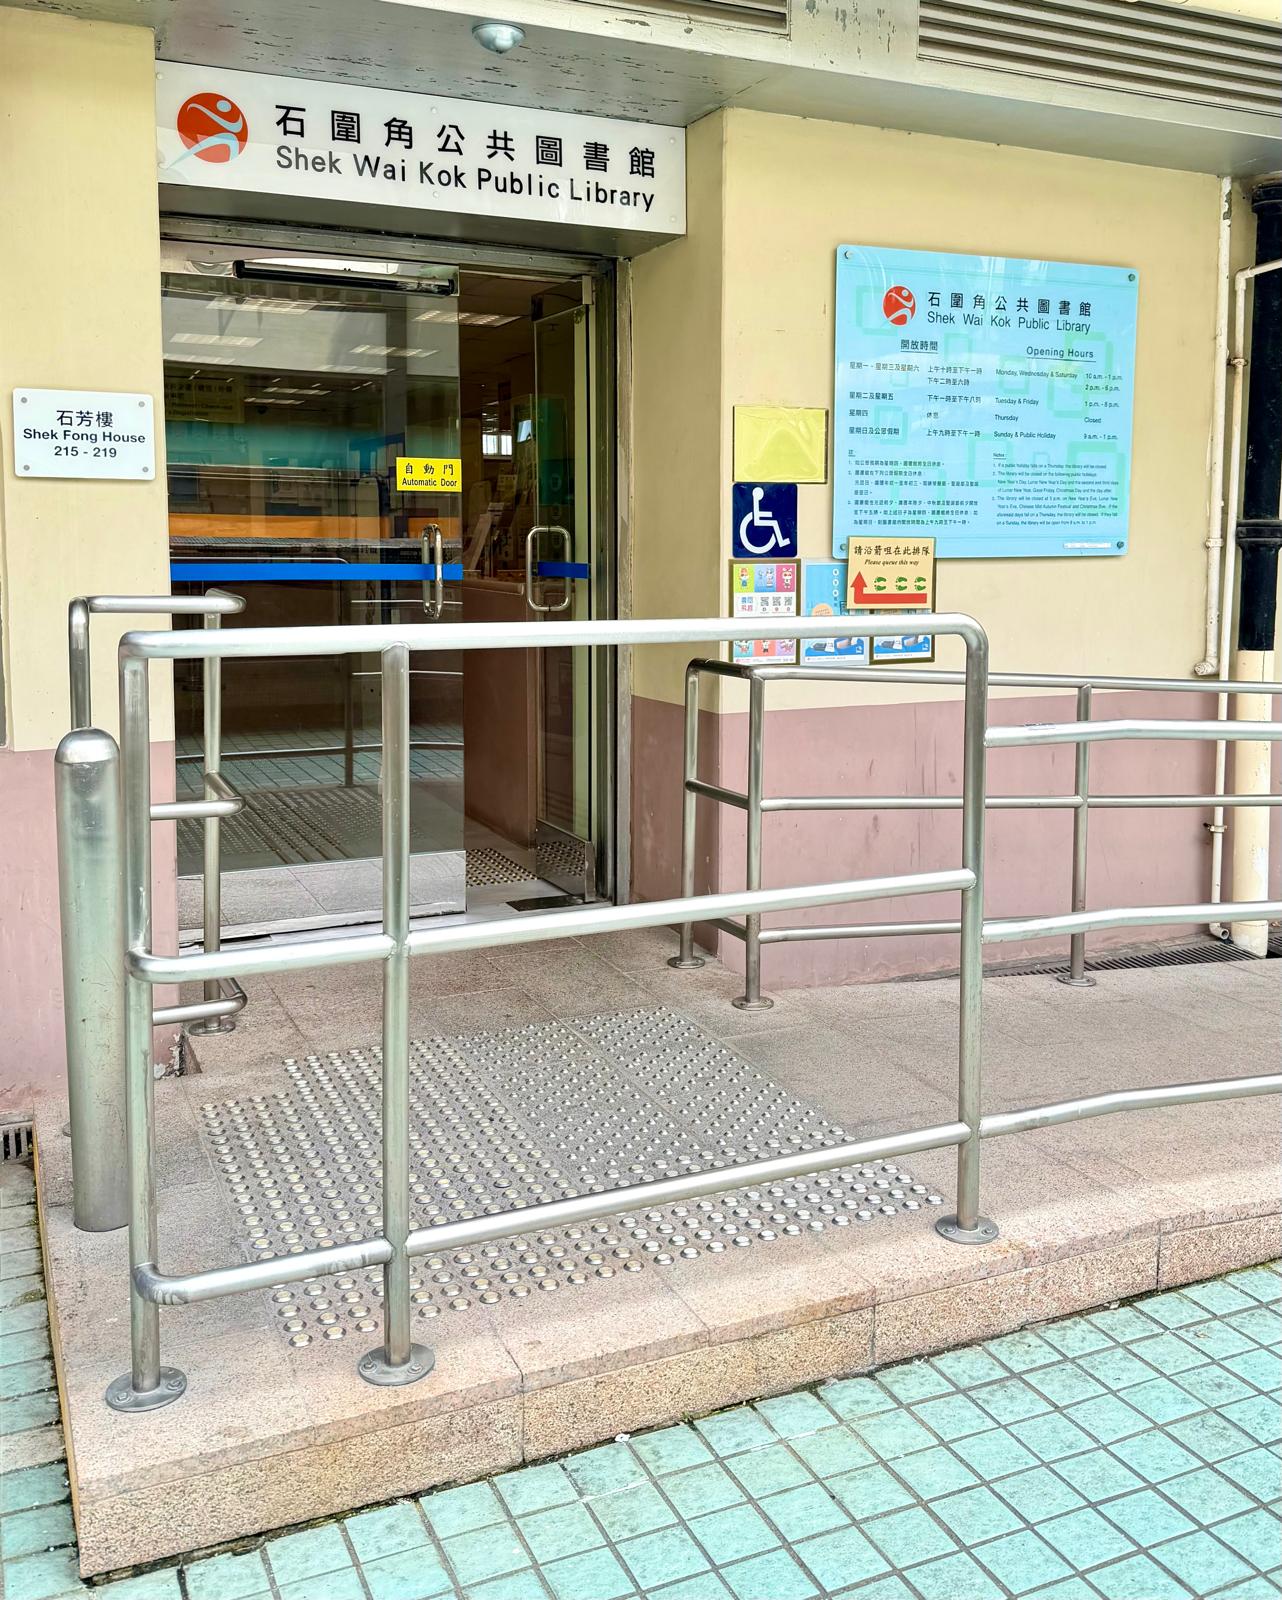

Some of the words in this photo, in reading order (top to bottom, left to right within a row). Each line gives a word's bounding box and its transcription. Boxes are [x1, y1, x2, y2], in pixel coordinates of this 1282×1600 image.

[275, 104, 655, 178] 石圍角公共圖書館
[276, 145, 342, 175] Shek
[353, 153, 406, 182] Wai
[419, 161, 467, 188] Kok
[478, 168, 560, 199] Public
[570, 178, 655, 213] Library
[927, 291, 1092, 317] 石圍角公共圖書館
[927, 310, 956, 326] Shek
[962, 313, 984, 327] Wai
[990, 315, 1011, 328] Kok
[1018, 317, 1050, 330] Public
[1056, 318, 1091, 334] Library
[900, 339, 938, 351] 開放時間
[1026, 346, 1064, 358] Opening
[1068, 348, 1094, 358] Hours
[850, 362, 869, 370] 星期一
[1019, 370, 1050, 378] Wednesday
[1055, 372, 1078, 381] Saturday
[850, 392, 894, 401] 星期二及星期五
[995, 398, 1017, 406] Tuesday
[56, 410, 113, 428] 石芳樓
[849, 409, 868, 417] 星期四
[994, 414, 1018, 423] Thursday
[23, 428, 58, 440] Shek
[63, 430, 98, 444] Fong
[102, 432, 146, 444] House
[994, 431, 1014, 440] Sunday
[1037, 434, 1056, 442] Holiday
[54, 446, 79, 457] 215
[93, 447, 117, 458] 219
[406, 463, 454, 476] 自動門
[402, 477, 437, 486] Automatic
[441, 478, 457, 487] Door
